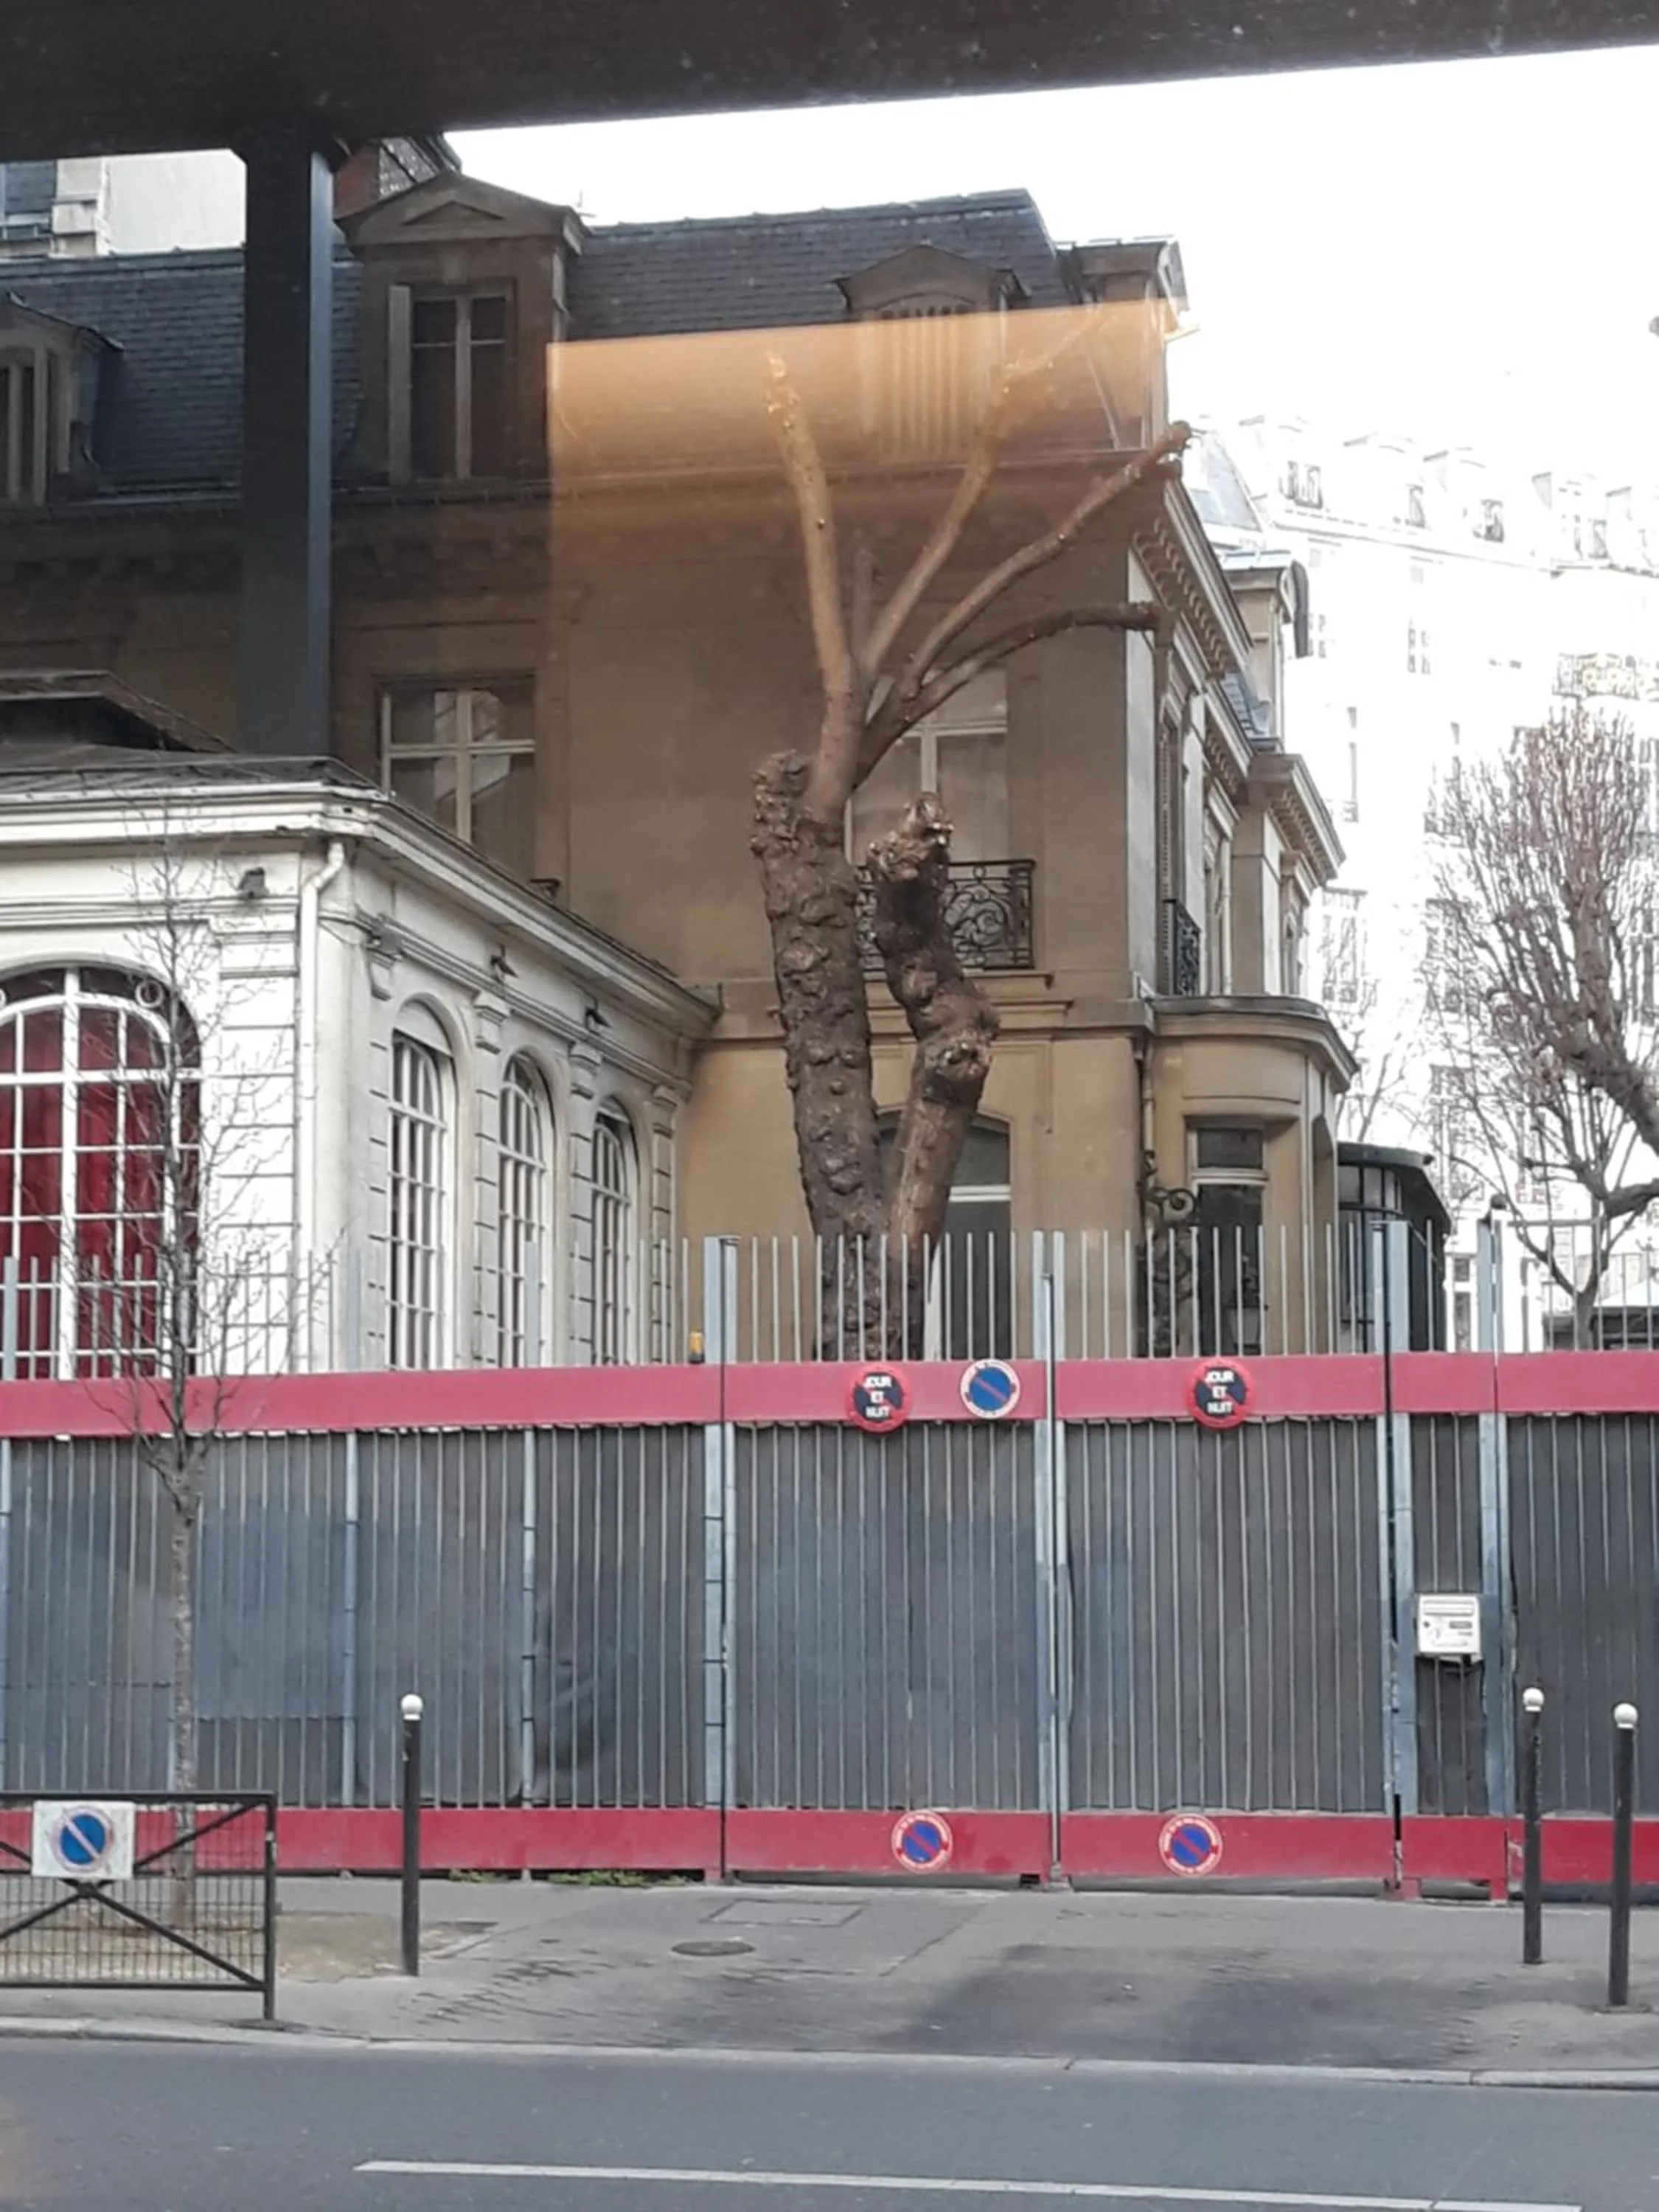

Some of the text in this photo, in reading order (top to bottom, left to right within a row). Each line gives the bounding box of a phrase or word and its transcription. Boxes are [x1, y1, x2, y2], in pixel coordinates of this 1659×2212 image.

[863, 1375, 891, 1388] JOUR
[1204, 1371, 1234, 1383] JOUR
[871, 1391, 884, 1403] ET
[1212, 1385, 1227, 1399] ET
[866, 1406, 889, 1417] NUIT
[1207, 1401, 1233, 1413] NUIT
